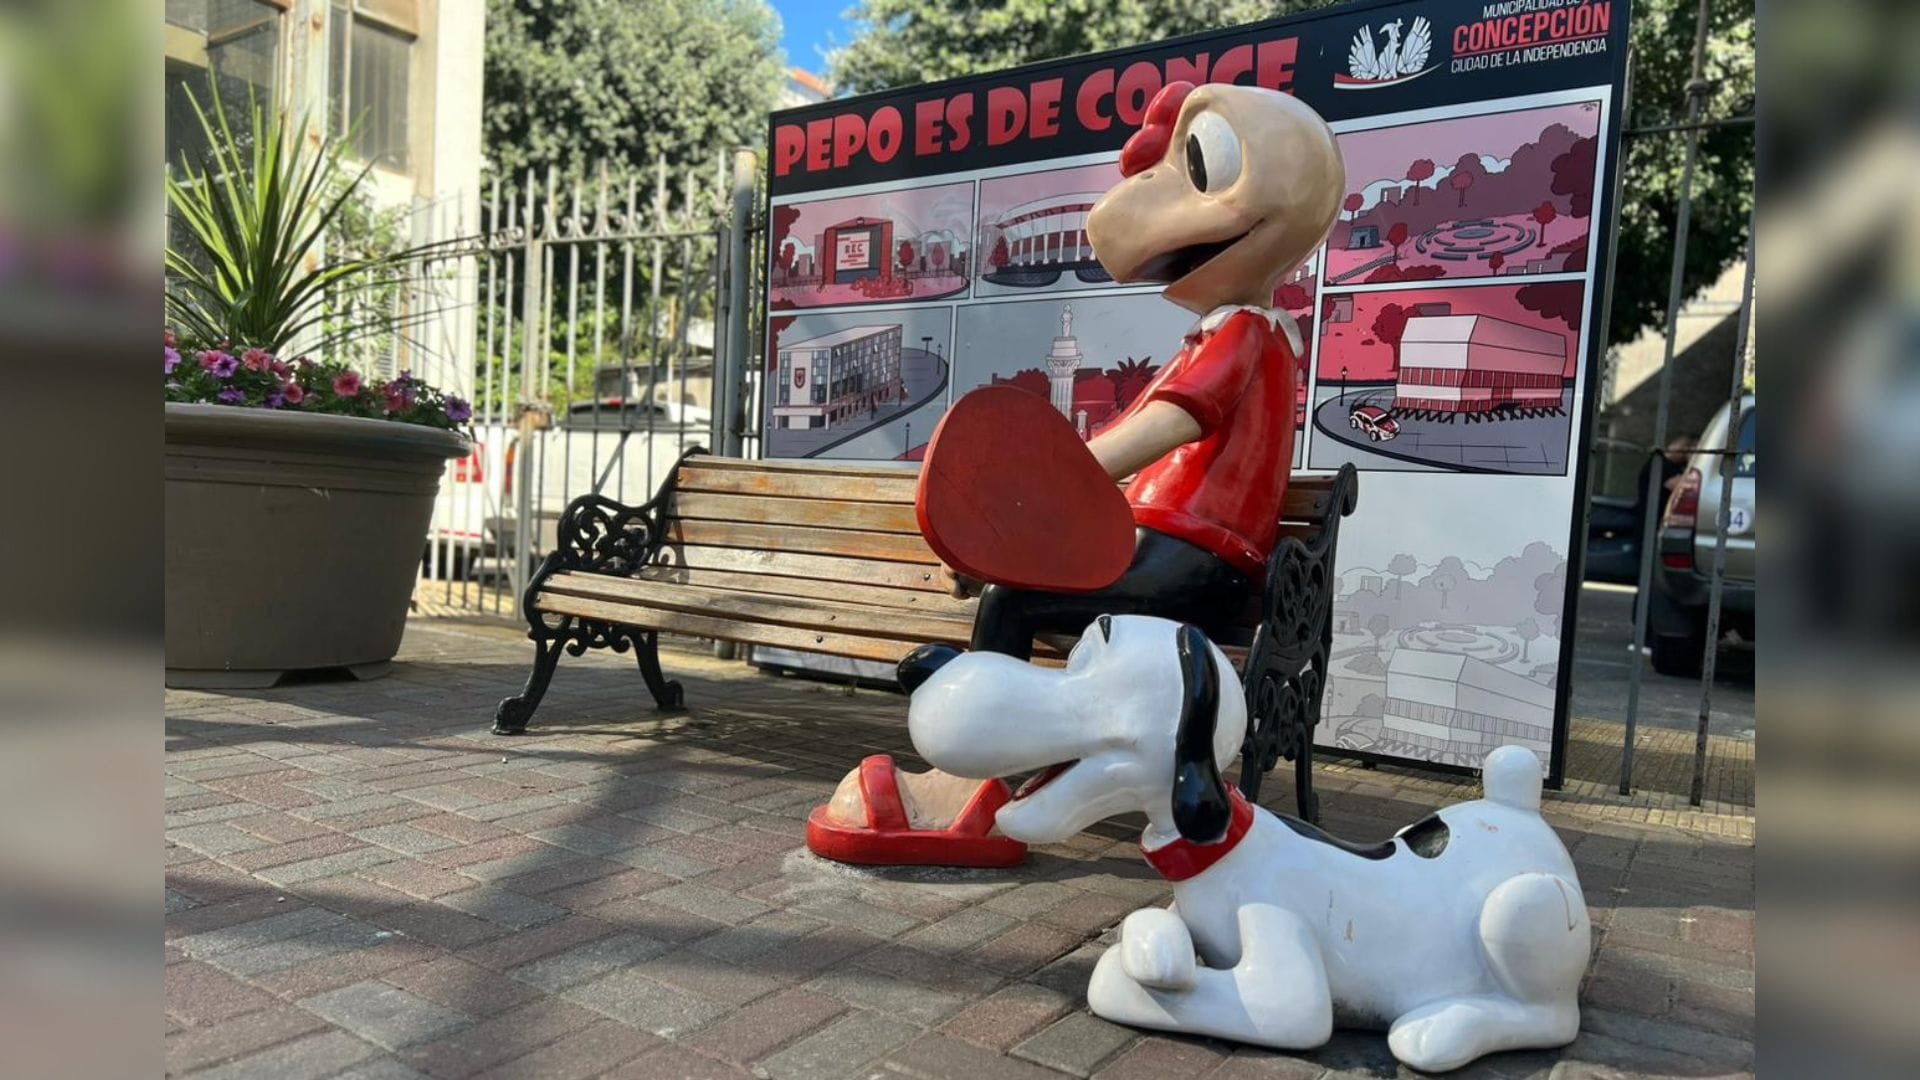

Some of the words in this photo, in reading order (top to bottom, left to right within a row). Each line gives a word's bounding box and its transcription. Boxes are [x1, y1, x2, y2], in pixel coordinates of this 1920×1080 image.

[1453, 0, 1611, 53] CONCEPCIÓN
[1451, 55, 1489, 74] CIUDAD
[1490, 52, 1505, 68] DE
[1506, 50, 1521, 66] LA
[1522, 37, 1607, 63] INDEPENDENCIA
[775, 105, 904, 177] PEPO
[915, 93, 975, 157] ES
[988, 78, 1064, 147] DE
